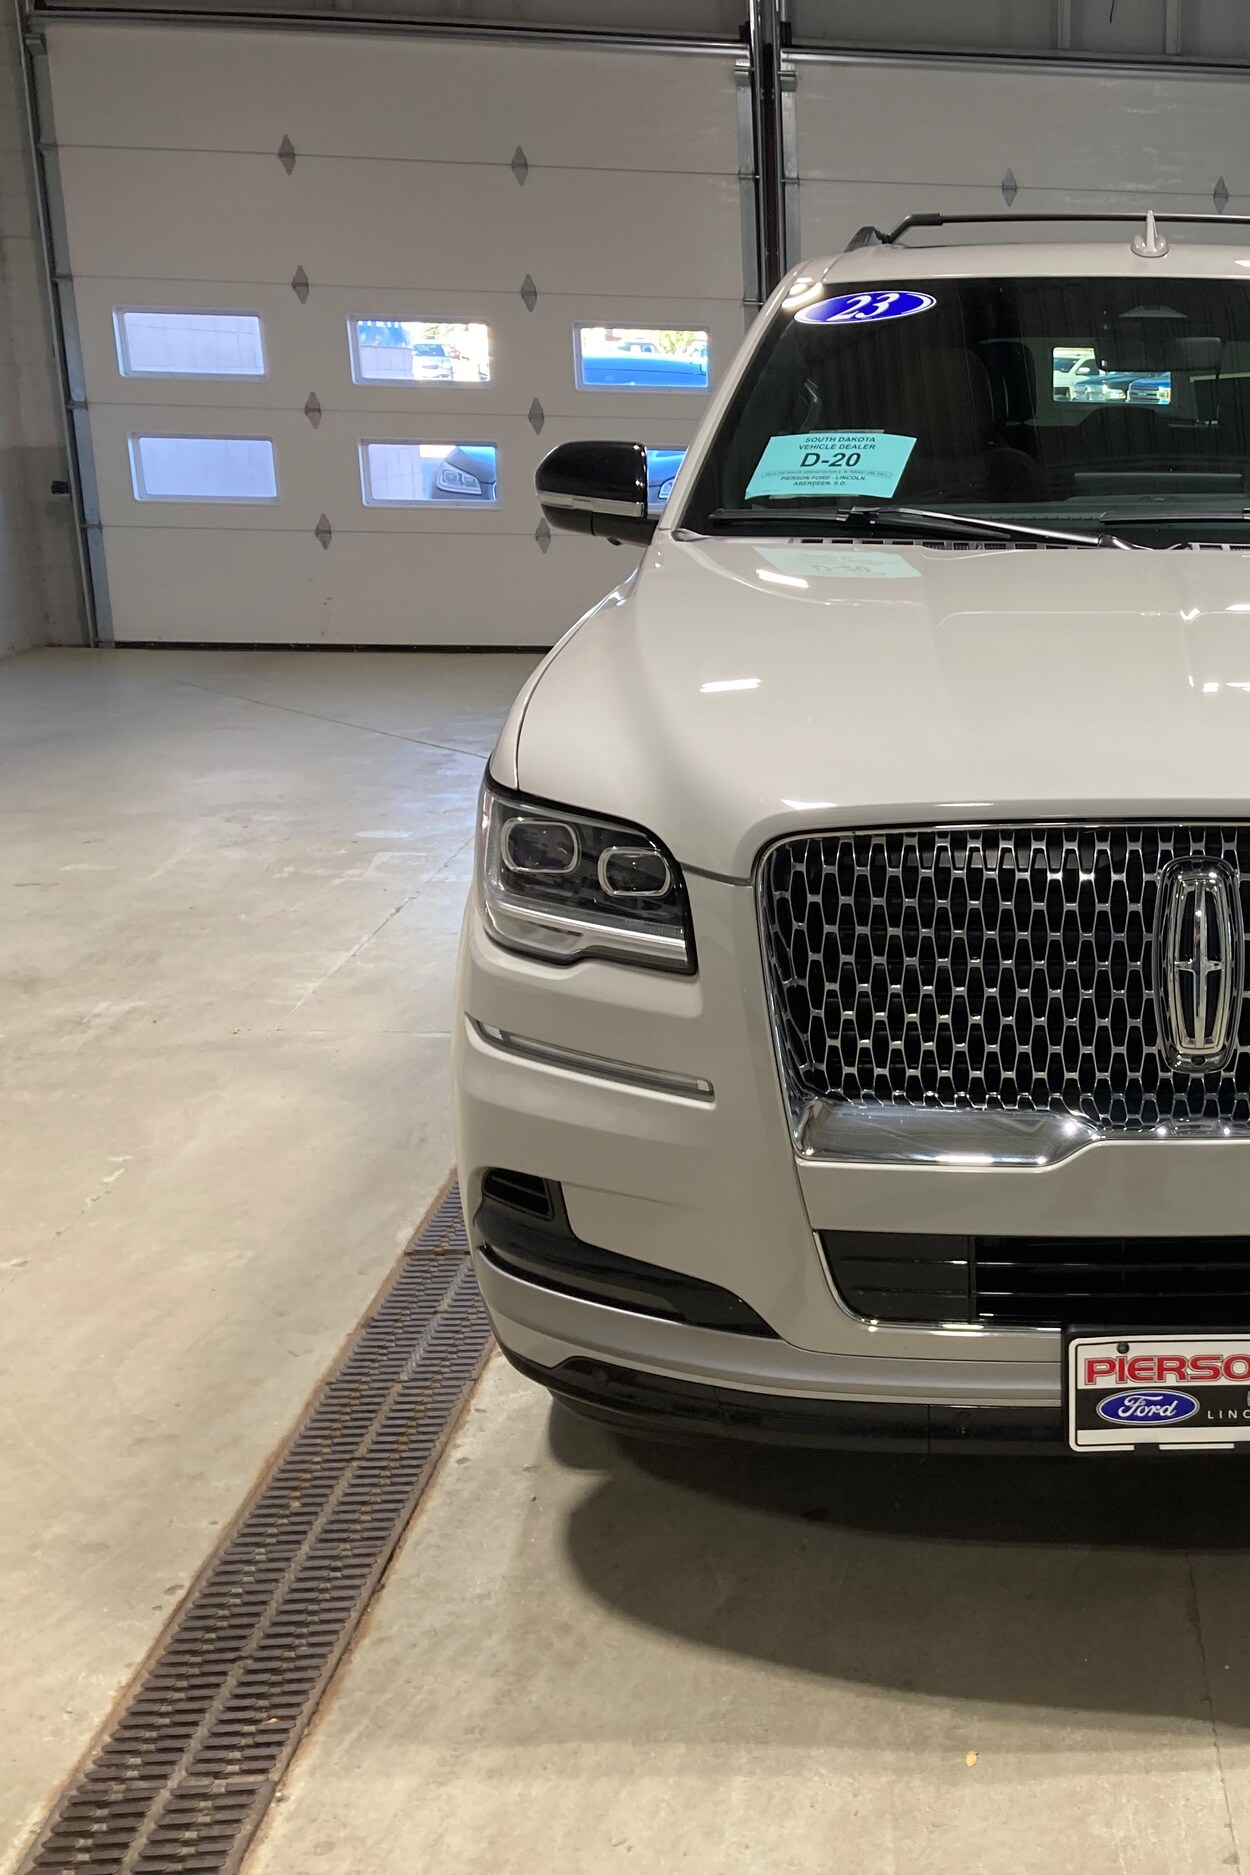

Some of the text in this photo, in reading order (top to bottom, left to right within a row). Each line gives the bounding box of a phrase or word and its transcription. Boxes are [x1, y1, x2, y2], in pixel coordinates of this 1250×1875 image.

[826, 293, 900, 321] 23
[800, 453, 861, 467] D-20
[1118, 1395, 1178, 1418] Ford
